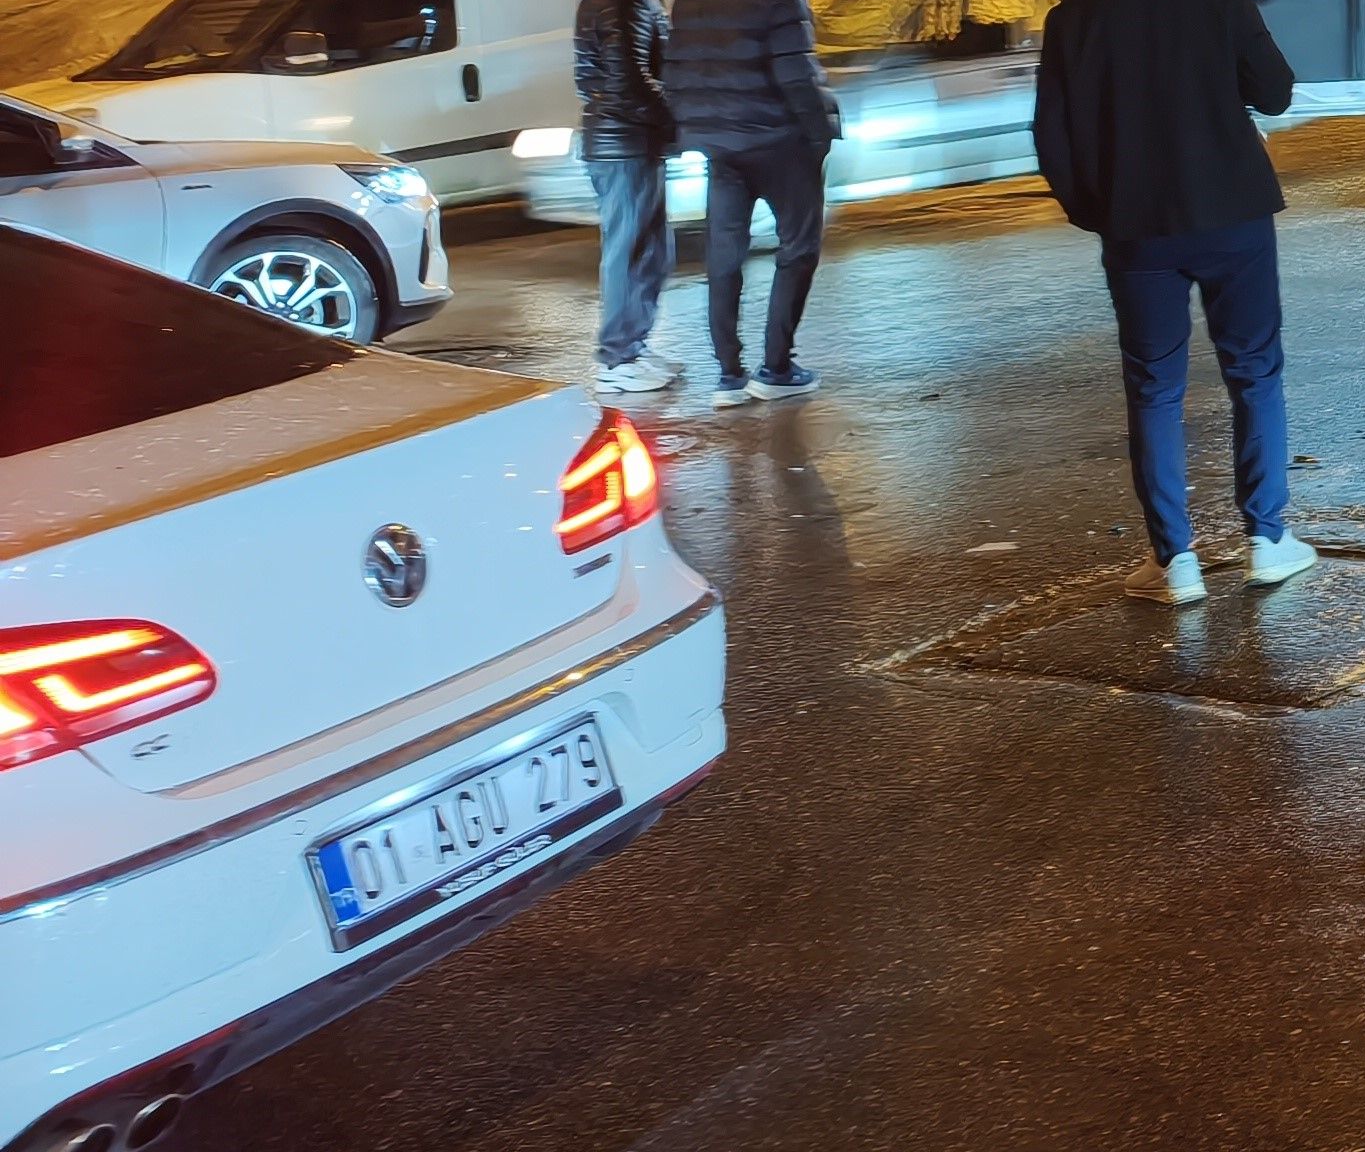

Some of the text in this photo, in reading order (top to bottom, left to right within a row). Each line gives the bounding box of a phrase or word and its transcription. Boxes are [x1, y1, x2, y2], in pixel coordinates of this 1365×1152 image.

[352, 828, 408, 900] 01
[431, 776, 510, 865] AGU
[526, 733, 601, 813] 279
